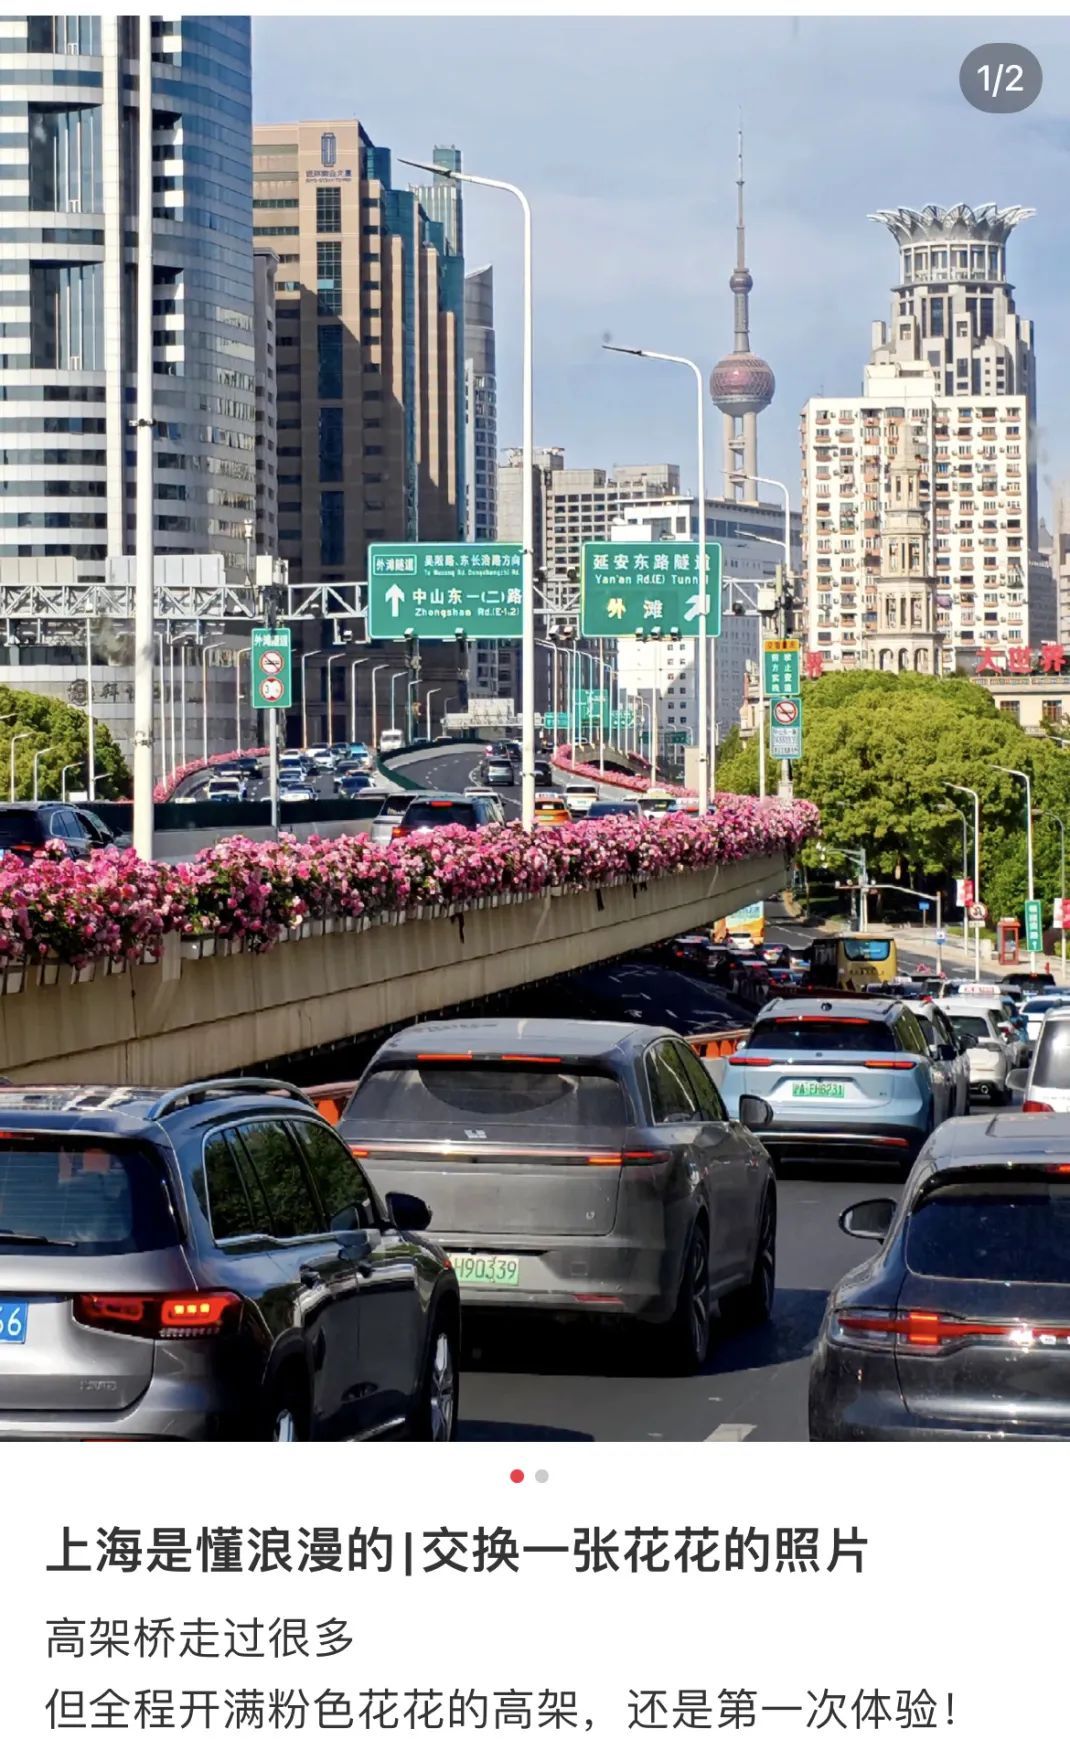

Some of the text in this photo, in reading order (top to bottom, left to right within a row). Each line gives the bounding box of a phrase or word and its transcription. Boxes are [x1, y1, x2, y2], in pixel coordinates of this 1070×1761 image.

[593, 553, 710, 571] 延安东路隧道
[671, 574, 709, 585] Tunnl
[607, 597, 663, 620] 外滩
[976, 643, 1066, 673] 大世界
